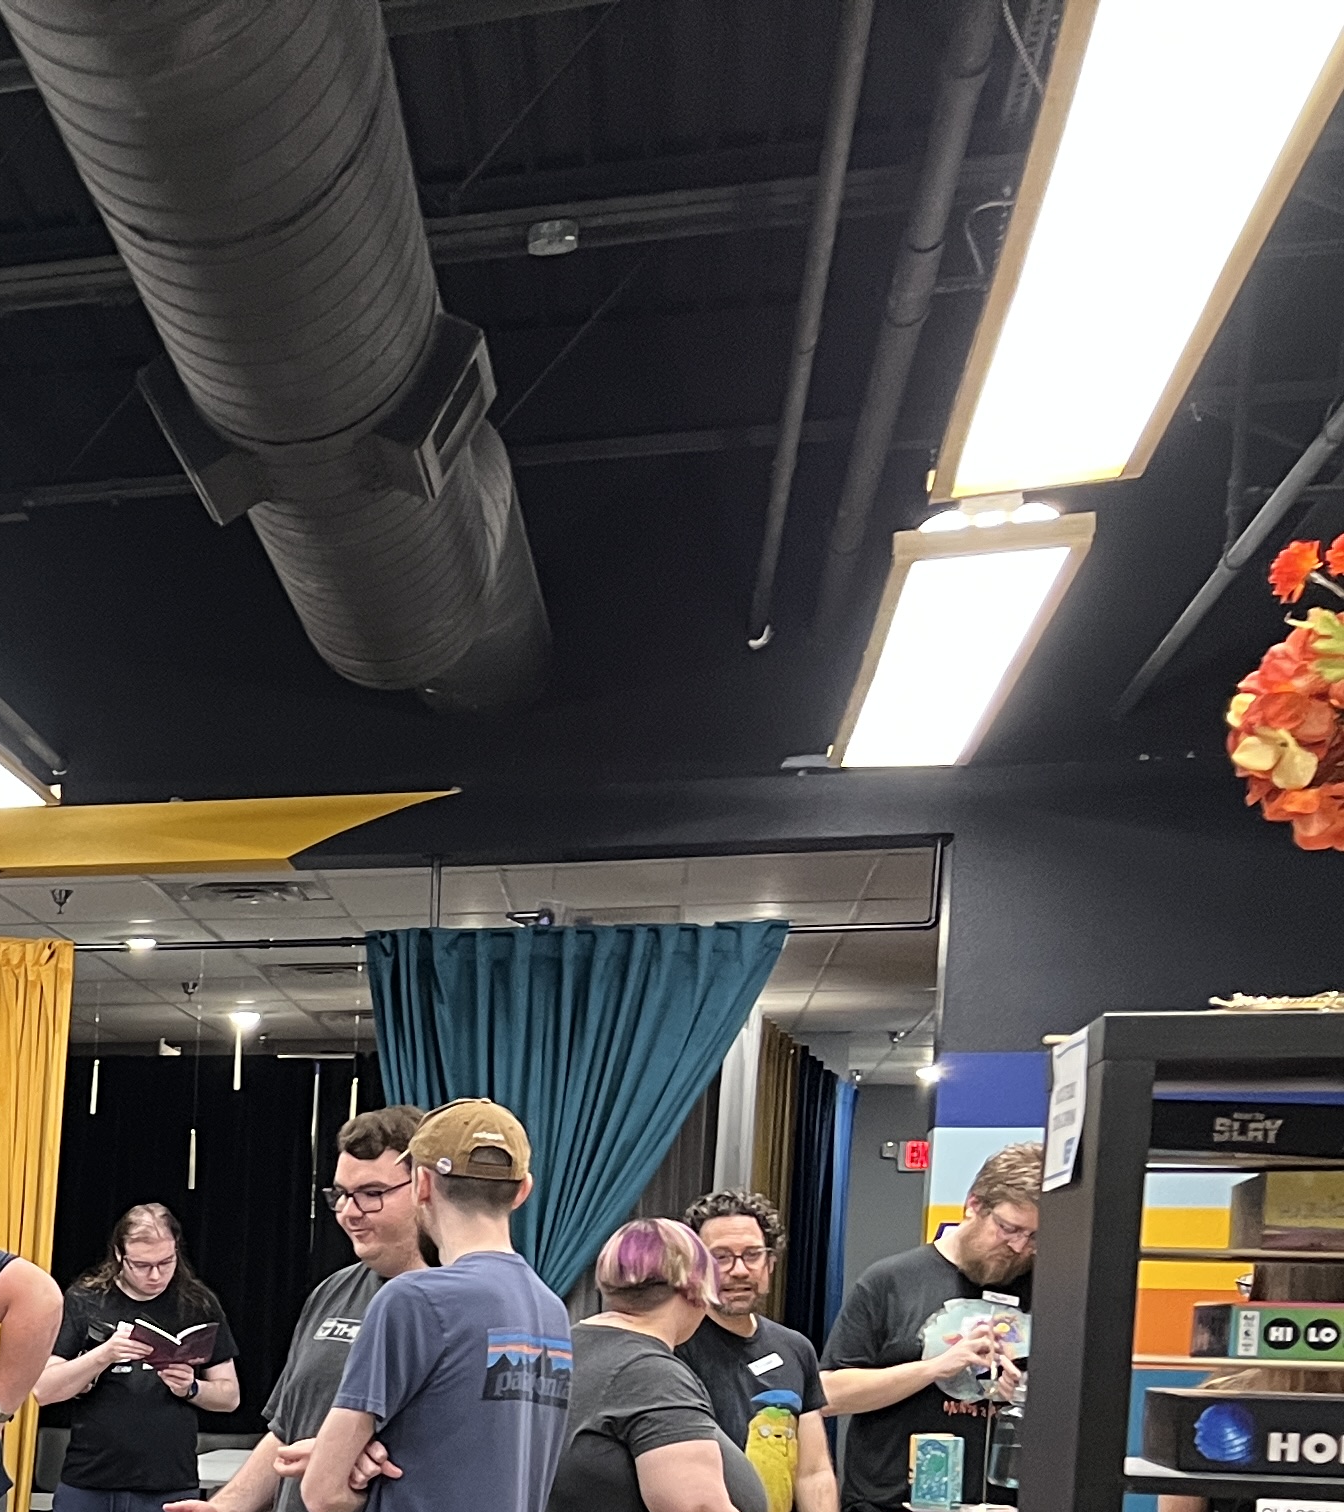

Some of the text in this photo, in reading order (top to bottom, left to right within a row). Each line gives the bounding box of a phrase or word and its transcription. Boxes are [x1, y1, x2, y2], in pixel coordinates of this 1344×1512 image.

[1212, 1117, 1284, 1144] SLAY
[1268, 1326, 1293, 1342] HI
[1306, 1326, 1338, 1343] LO
[1267, 1432, 1344, 1465] HO
